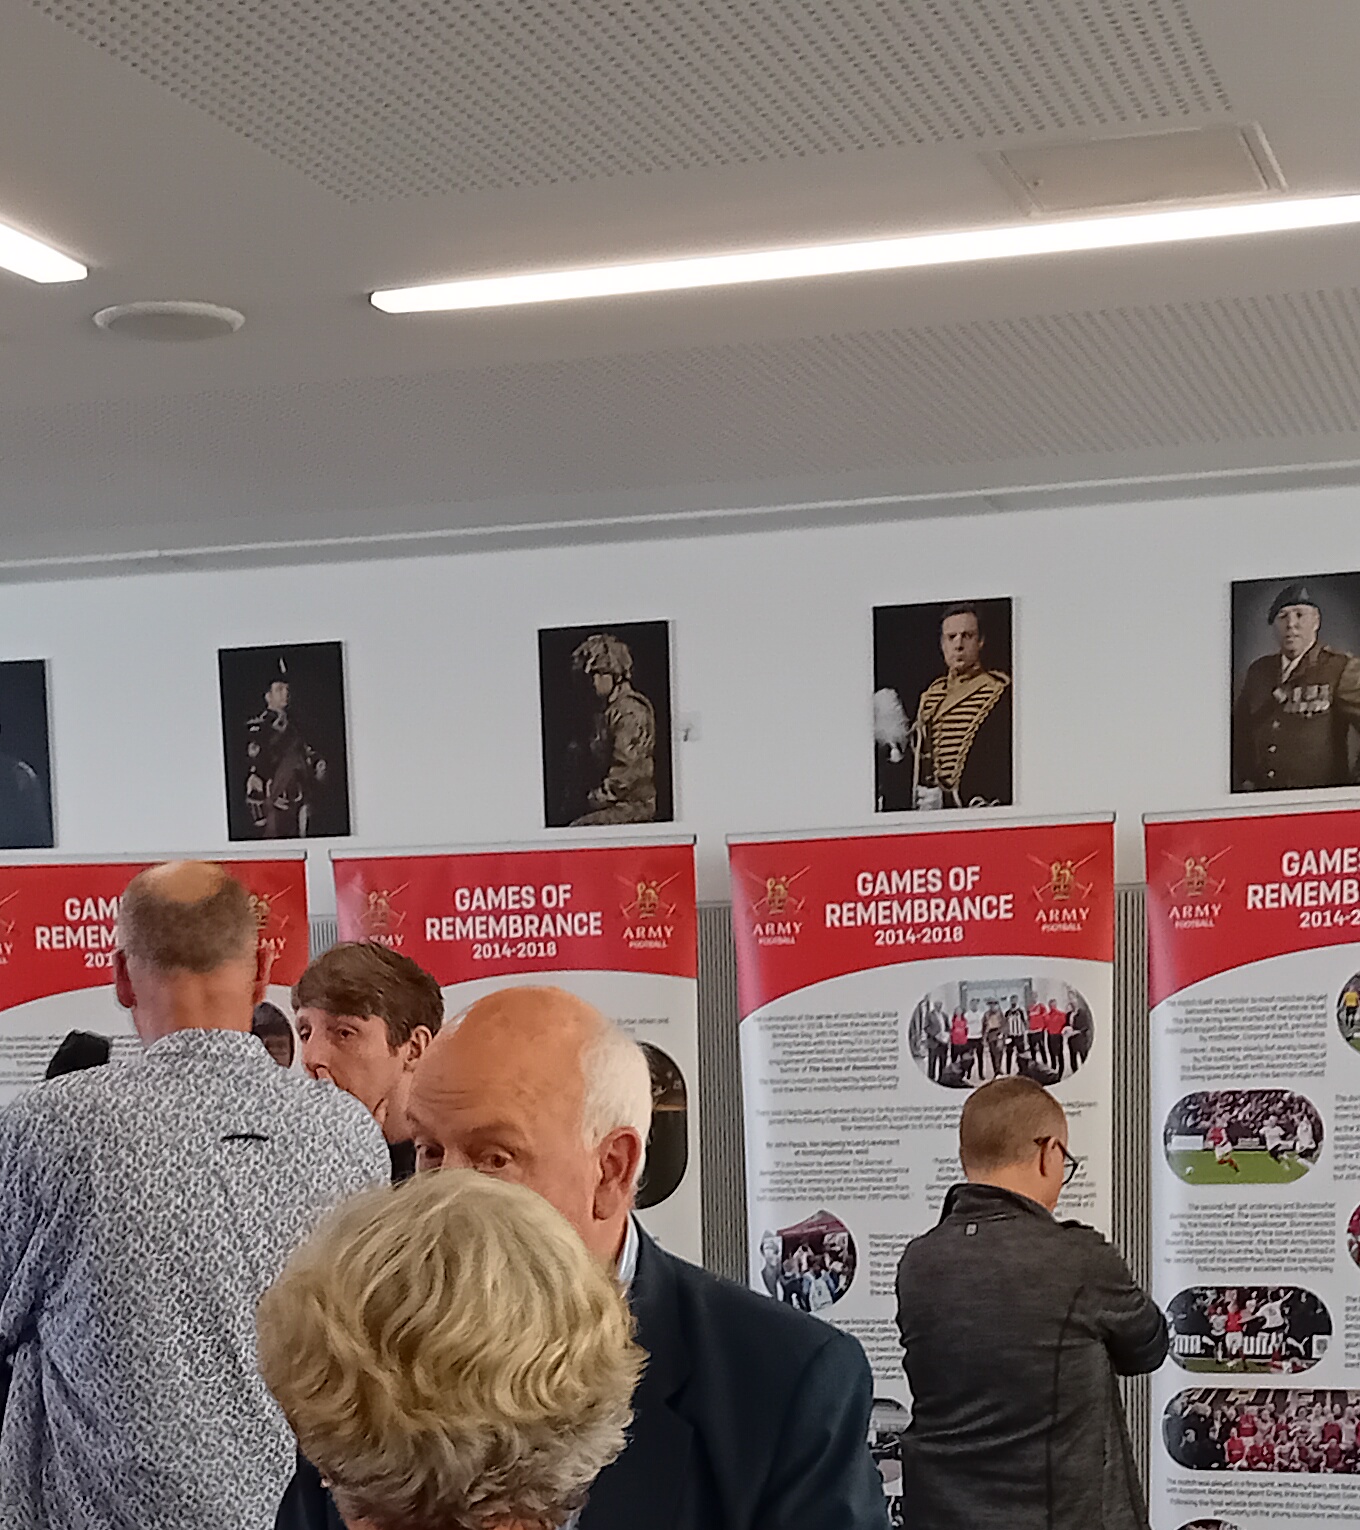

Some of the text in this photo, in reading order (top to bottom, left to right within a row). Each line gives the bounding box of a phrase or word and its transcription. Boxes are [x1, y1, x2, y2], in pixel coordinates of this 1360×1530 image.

[857, 865, 981, 896] GAMES OF
[455, 884, 572, 911] GAMES OF
[64, 895, 123, 921] GAM
[825, 894, 1014, 928] REMEMBRANCE
[1035, 907, 1090, 923] ARMY
[1169, 903, 1222, 919] ARMY
[425, 911, 603, 941] REMEMBRANCE
[622, 925, 674, 940] ARMY
[753, 922, 803, 936] ARMY
[874, 926, 964, 946] 2014-2018
[35, 924, 119, 950] REMEM
[84, 951, 114, 968] 201
[472, 941, 558, 960] 2014-2018
